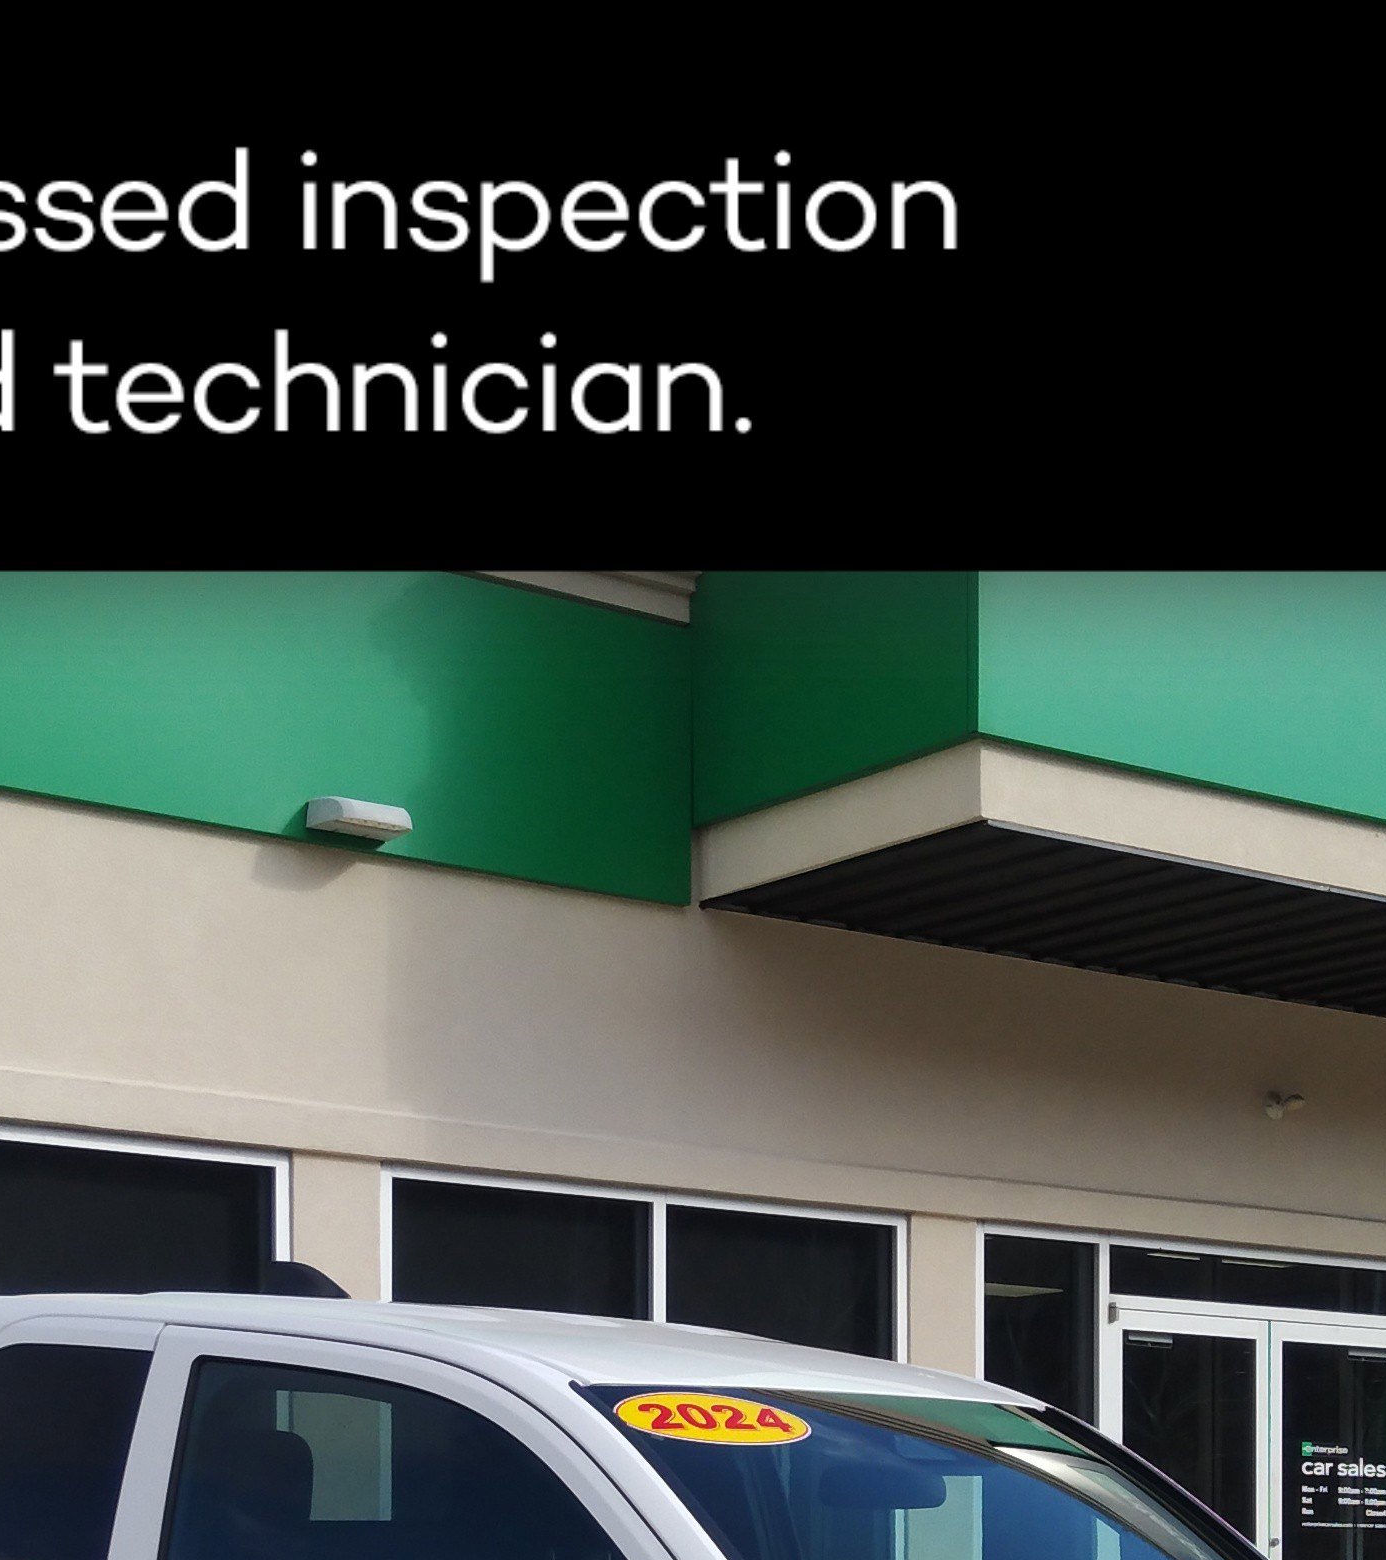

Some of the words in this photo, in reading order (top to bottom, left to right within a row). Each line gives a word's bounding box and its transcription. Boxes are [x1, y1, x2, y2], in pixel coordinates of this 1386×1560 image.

[638, 1403, 795, 1433] 2024
[1302, 1461, 1333, 1476] car
[1337, 1457, 1386, 1478] sales
